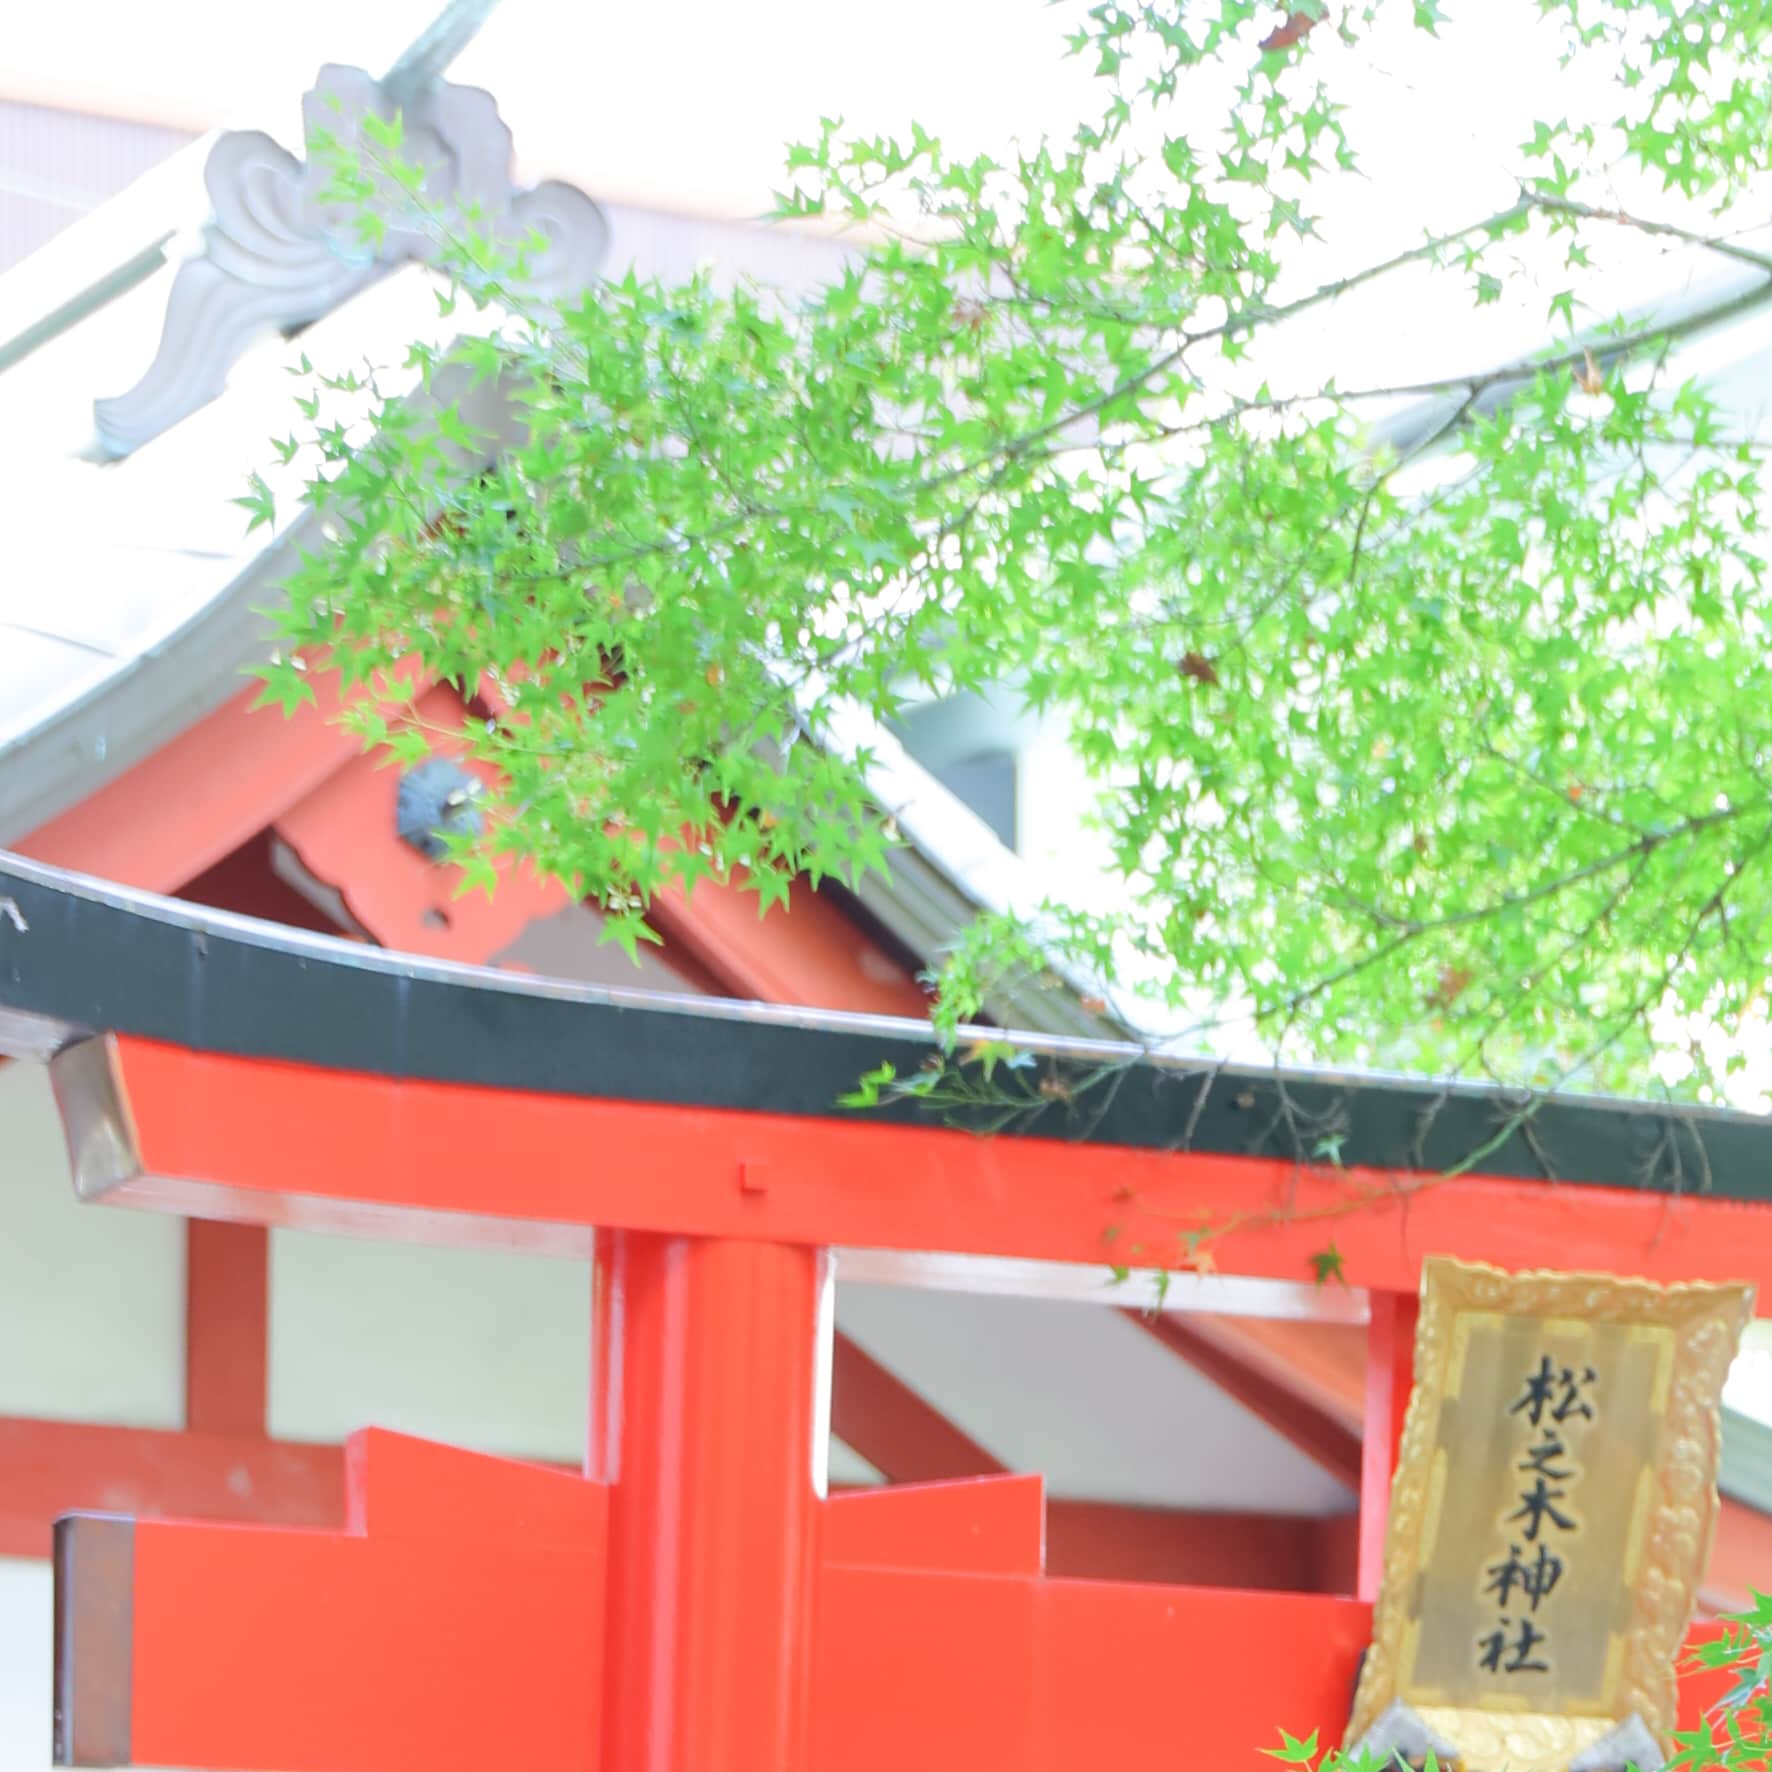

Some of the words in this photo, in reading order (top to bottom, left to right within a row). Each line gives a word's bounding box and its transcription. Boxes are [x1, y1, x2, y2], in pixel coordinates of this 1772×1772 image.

[1477, 1355, 1597, 1674] 松之木神社
